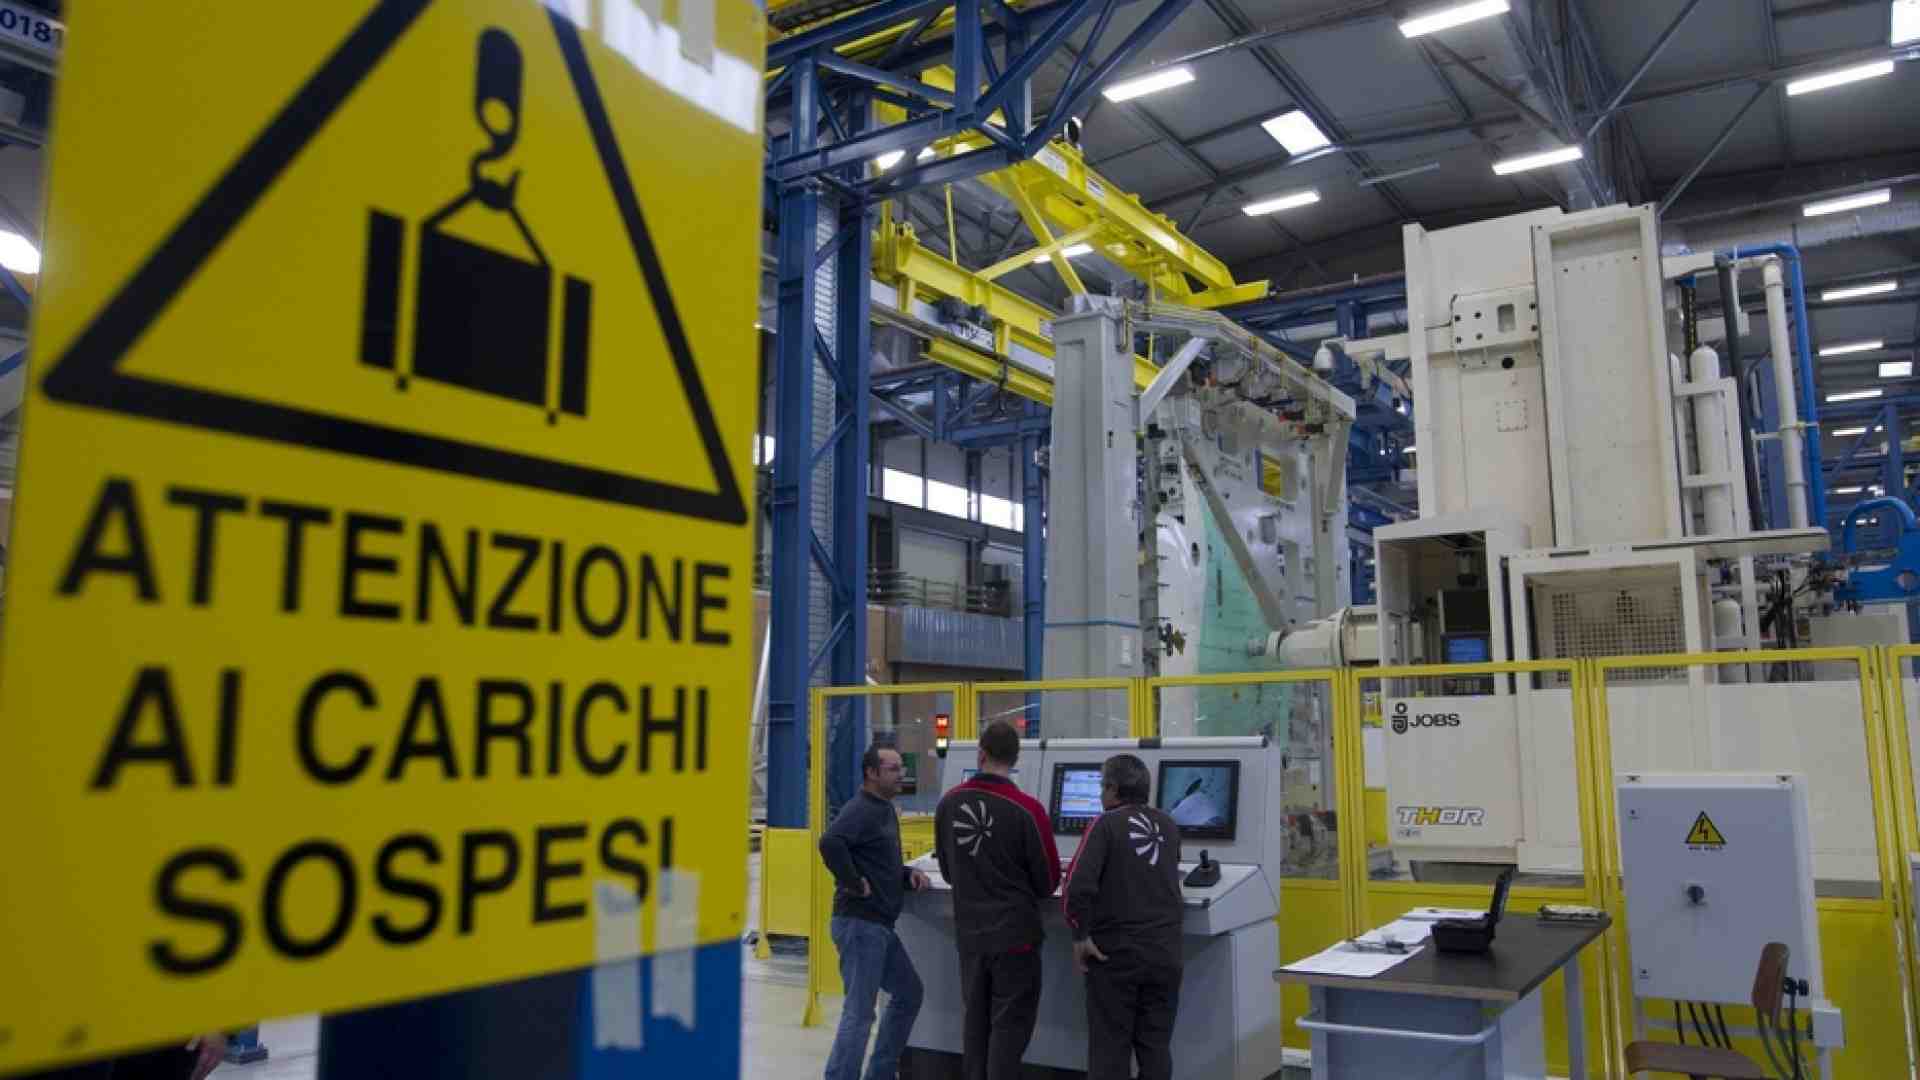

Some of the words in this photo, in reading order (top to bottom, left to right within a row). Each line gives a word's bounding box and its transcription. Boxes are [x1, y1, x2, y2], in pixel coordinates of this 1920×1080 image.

[56, 477, 732, 646] ATTENZIONE
[88, 666, 241, 790] AI
[294, 670, 709, 787] CARICHI
[1409, 713, 1460, 728] JOBS
[1396, 806, 1486, 826] THOR
[146, 817, 675, 978] SOSPESI
